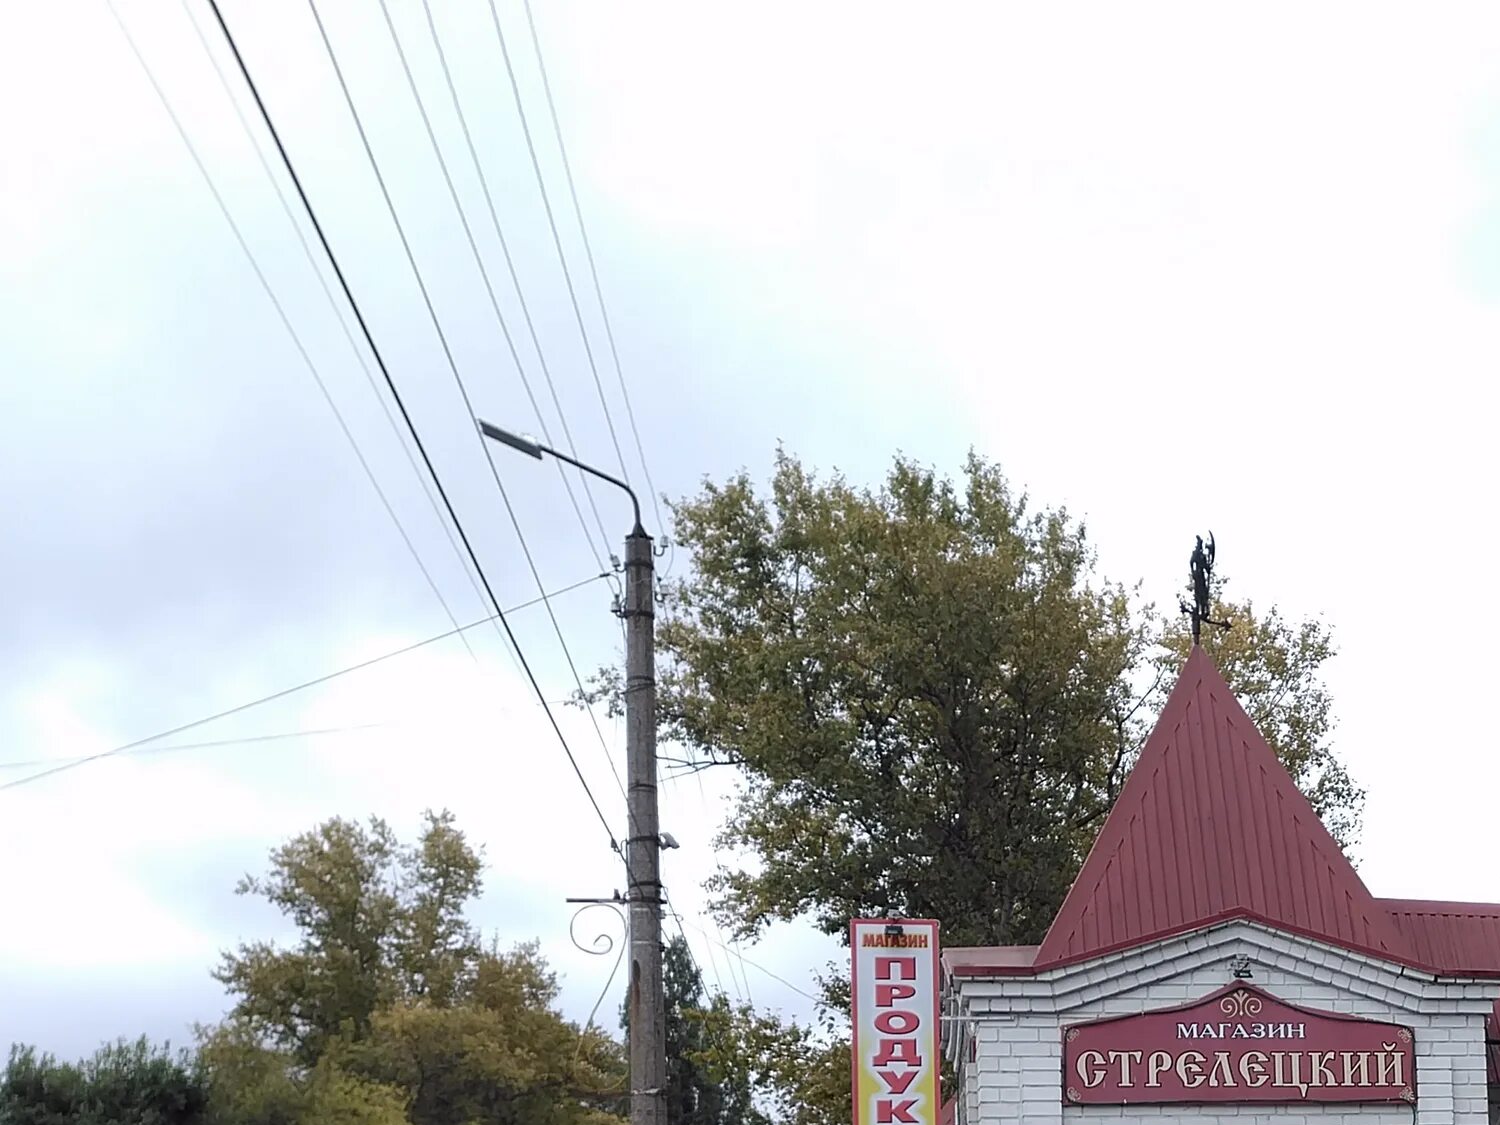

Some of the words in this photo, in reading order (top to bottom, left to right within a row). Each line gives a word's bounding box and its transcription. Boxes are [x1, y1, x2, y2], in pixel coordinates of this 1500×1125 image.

[862, 933, 928, 949] МАГАЗИН
[1176, 1022, 1306, 1040] МАГАЗИН
[1076, 1042, 1406, 1098] СТРЕЛЕЦКИЙ
